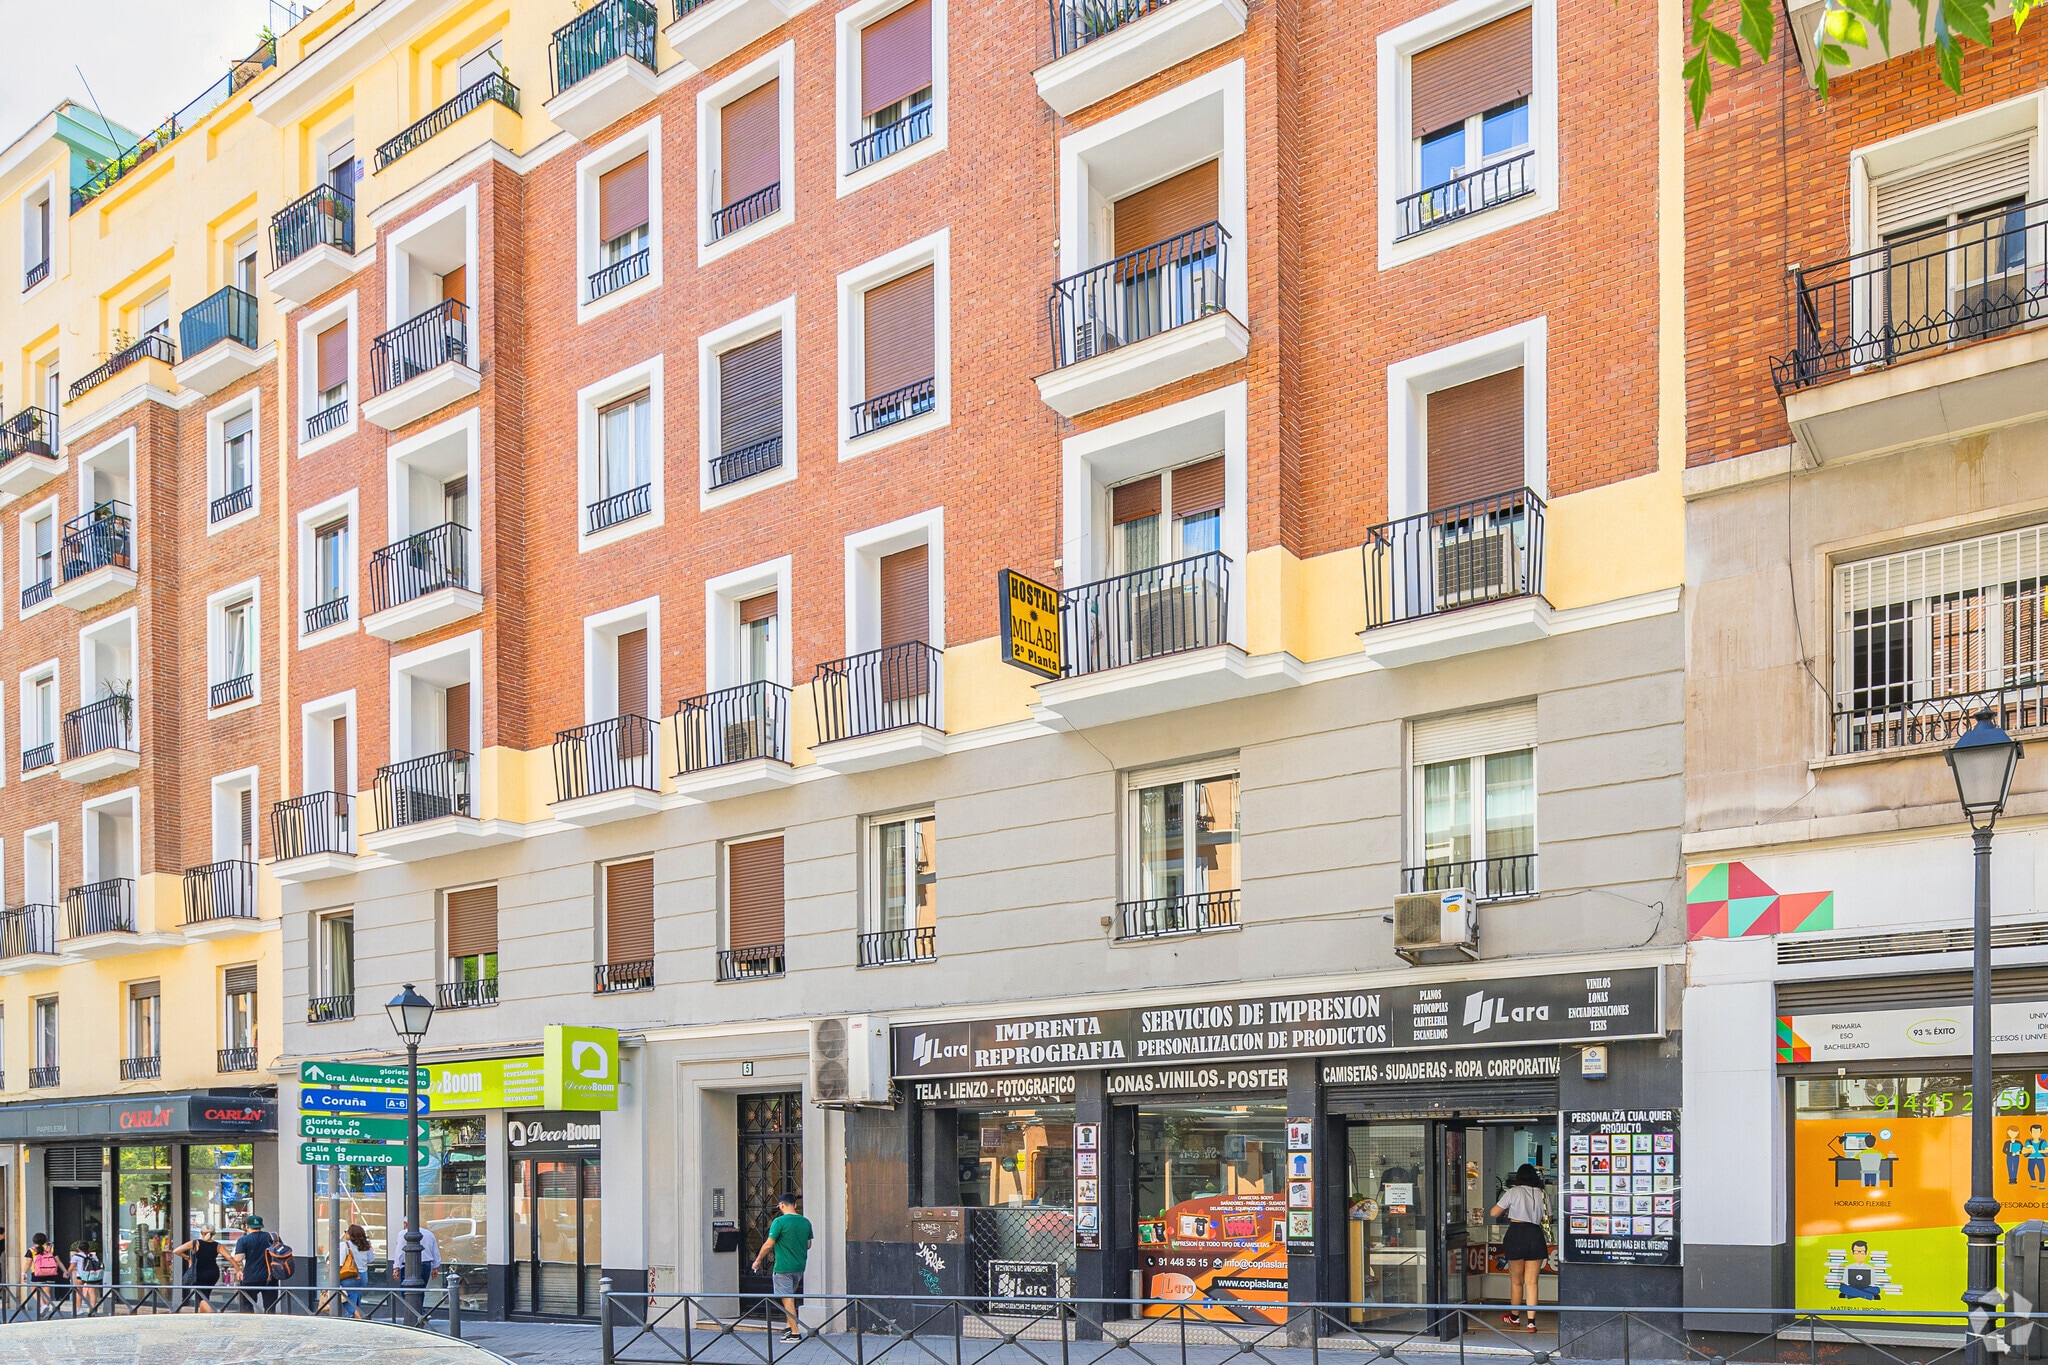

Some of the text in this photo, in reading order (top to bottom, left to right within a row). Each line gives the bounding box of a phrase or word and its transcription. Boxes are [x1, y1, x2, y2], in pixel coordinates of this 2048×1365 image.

[1011, 577, 1055, 615] HOSTAL
[1012, 615, 1057, 653] MILABI
[1028, 649, 1057, 671] Planta
[1586, 977, 1611, 989] VINILOS
[1419, 989, 1442, 1001] PLANOS
[1588, 992, 1609, 1003] LONAS
[1141, 994, 1381, 1033] SERVICIOS DE IMPRESION
[1413, 1002, 1449, 1014] FOTOCOPIAS
[1495, 998, 1549, 1023] Lara
[1568, 1004, 1629, 1019] ENCUADERNACIONES
[1413, 1015, 1448, 1027] CARTELERIA
[1590, 1020, 1607, 1031] TESIS
[1831, 1022, 1862, 1030] PRIMARIA
[995, 1016, 1101, 1042] IMPRENTA
[1413, 1029, 1448, 1041] ESCANEADOS
[1913, 1027, 1956, 1036] 93 % ÉXITO
[1137, 1025, 1386, 1057] PERSONALIZACION DE PRODUCTOS
[1823, 1042, 1870, 1051] BACHILLERATO
[933, 1038, 968, 1059] Lara
[974, 1040, 1125, 1068] REPROGRAFIA
[380, 1068, 409, 1077] glorieta
[745, 1063, 751, 1073] 5
[1323, 1064, 1378, 1083] CAMISETAS
[1385, 1061, 1447, 1081] SUDADERAS
[1455, 1060, 1483, 1078] ROPA
[350, 1073, 382, 1084] Álvarez
[384, 1077, 396, 1085] de
[397, 1077, 427, 1086] Caro
[1106, 1068, 1288, 1093] LONAS VINILOS POSTER
[915, 1076, 1076, 1100] TELA LIENZO FOTOGRAFICO
[305, 1095, 405, 1107] A Coruña A-6
[2000, 1090, 2031, 1111] 50
[305, 1117, 360, 1126] glorieta de
[1571, 1110, 1672, 1123] PERSONALIZA CUALQUIER
[305, 1125, 360, 1136] Quevedo
[527, 1122, 600, 1144] DecorBoom
[1600, 1123, 1642, 1134] PRODUCTO
[305, 1152, 393, 1163] San Bernardo
[1158, 1257, 1168, 1266] 91
[1170, 1257, 1185, 1266] 448
[1186, 1258, 1196, 1267] 56
[1198, 1258, 1208, 1268] 15
[1165, 1278, 1193, 1294] Lara
